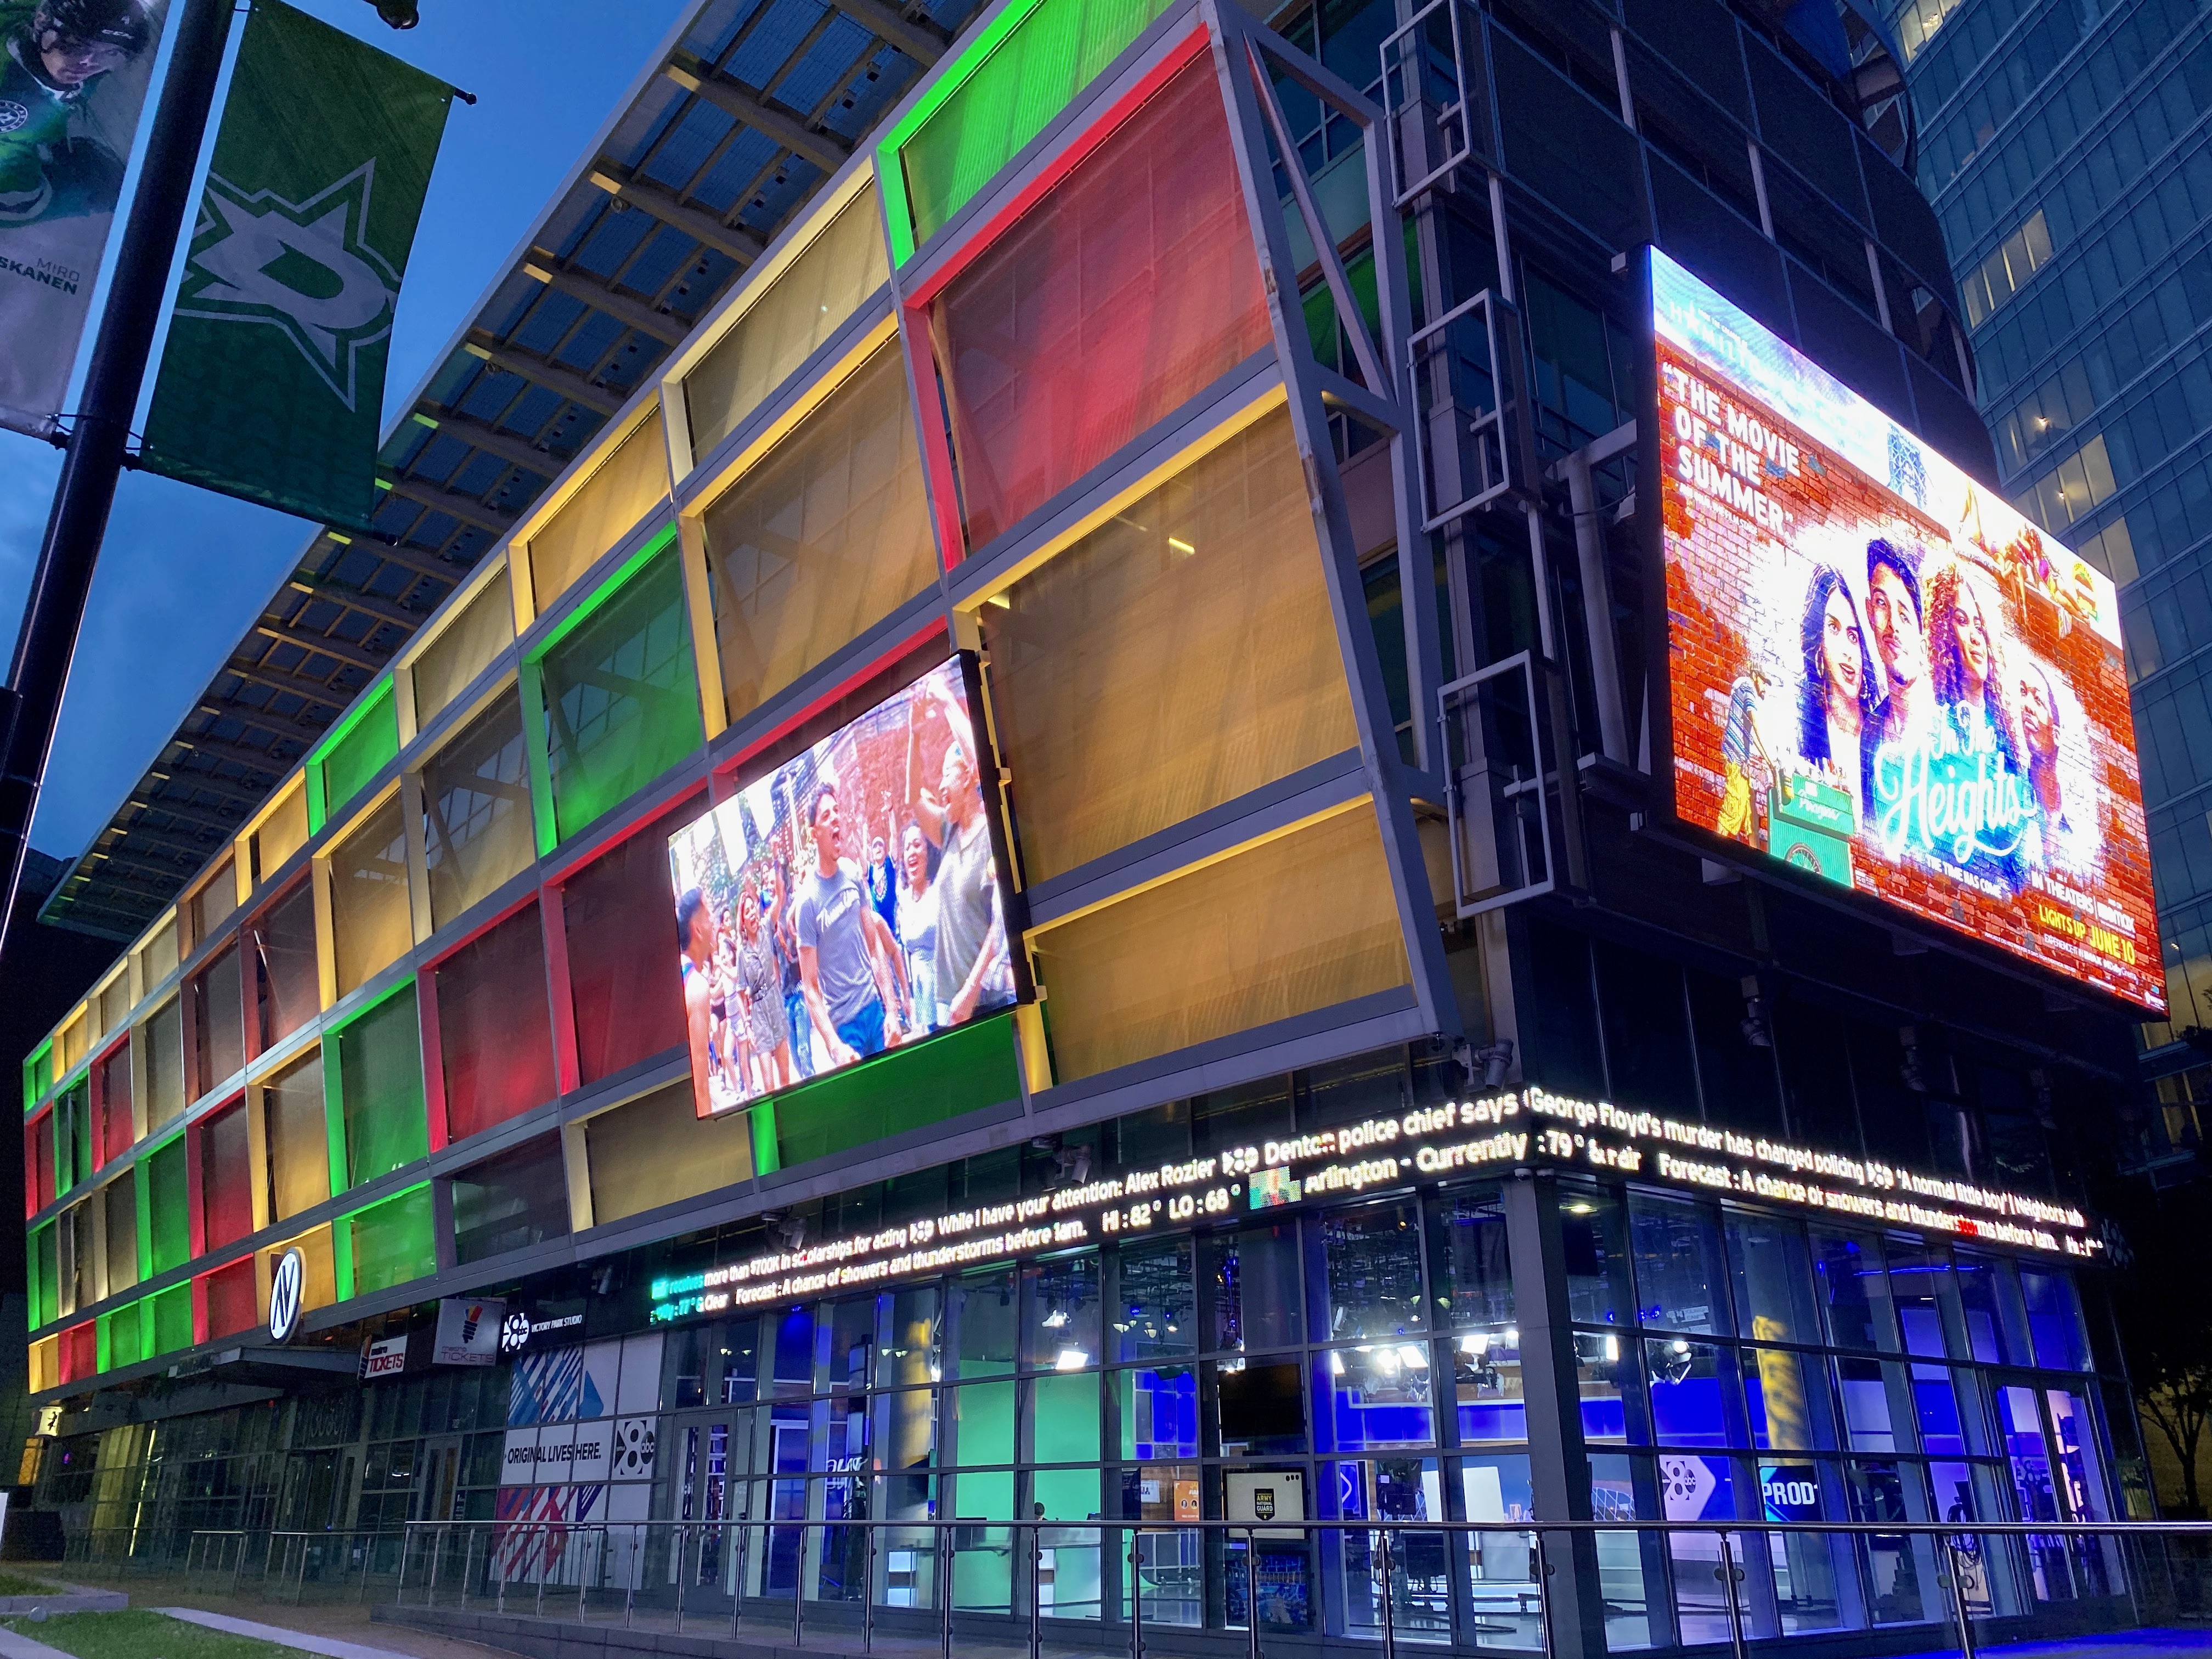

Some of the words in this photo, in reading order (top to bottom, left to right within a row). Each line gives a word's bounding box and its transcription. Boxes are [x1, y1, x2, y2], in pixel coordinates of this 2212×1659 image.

[0, 256, 77, 295] SKANEN
[37, 258, 80, 282] MIRO
[1676, 406, 1707, 447] OF
[1716, 431, 1761, 486] THE
[1728, 403, 1800, 478] MOVIE
[1956, 699, 1997, 757] The
[1874, 741, 2038, 865] Heights
[1927, 853, 1944, 874] THE
[1944, 860, 1963, 882] TIME
[1963, 868, 1980, 889] HAS
[1980, 878, 2003, 900] COME
[2031, 870, 2044, 891] IN
[2045, 877, 2094, 915] THEATERS
[2039, 904, 2073, 934] LIGHTS
[2073, 919, 2086, 939] UP
[2090, 924, 2121, 959] JUNE
[2121, 939, 2135, 966] 10
[1338, 1119, 1400, 1154] police
[1403, 1102, 1457, 1136] chief
[1460, 1092, 1520, 1123] says
[1598, 1102, 1662, 1138] Floyd's
[1664, 1120, 1723, 1150] murder
[1725, 1130, 1754, 1158] has
[1756, 1138, 1814, 1172] changed
[1814, 1153, 1865, 1186] policing
[938, 1211, 974, 1235] While
[975, 1209, 980, 1227] I
[982, 1204, 1015, 1226] have
[1016, 1195, 1050, 1222] your
[1052, 1181, 1123, 1211] attention:
[1125, 1171, 1159, 1194] Alex
[1160, 1158, 1217, 1186] Rozier
[1305, 1158, 1398, 1193] Arlington
[1416, 1131, 1528, 1172] Currently
[1741, 1169, 1755, 1193] A
[1756, 1173, 1806, 1203] chance
[1886, 1202, 1910, 1223] and
[1995, 1221, 2032, 1246] before
[1912, 1175, 1957, 1201] normal
[1956, 1182, 1984, 1207] little
[2014, 1195, 2066, 1223] Neighbors
[704, 1270, 728, 1287] more
[729, 1265, 750, 1282] than
[751, 1256, 780, 1275] $700K
[781, 1254, 791, 1268] in
[854, 1235, 872, 1254] for
[873, 1228, 906, 1250] acting
[704, 1294, 729, 1311] Clear
[782, 1278, 792, 1296] A
[792, 1272, 826, 1294] chance
[827, 1267, 840, 1286] of
[841, 1260, 888, 1283] showers
[889, 1254, 912, 1274] and
[912, 1236, 1003, 1269] thunderstorms
[1005, 1227, 1052, 1251] before
[1053, 1220, 1088, 1242] 1am.
[532, 1321, 551, 1333] VICTORY
[551, 1318, 563, 1328] PARK
[564, 1314, 583, 1326] STUDIO
[370, 1353, 403, 1373] TICKETS
[441, 1351, 493, 1363] TICKETS
[508, 1446, 546, 1464] ORIGINAL
[548, 1444, 572, 1463] LIVES
[574, 1442, 601, 1460] HERE.
[640, 1442, 654, 1452] abc
[1684, 1476, 1696, 1486] abc
